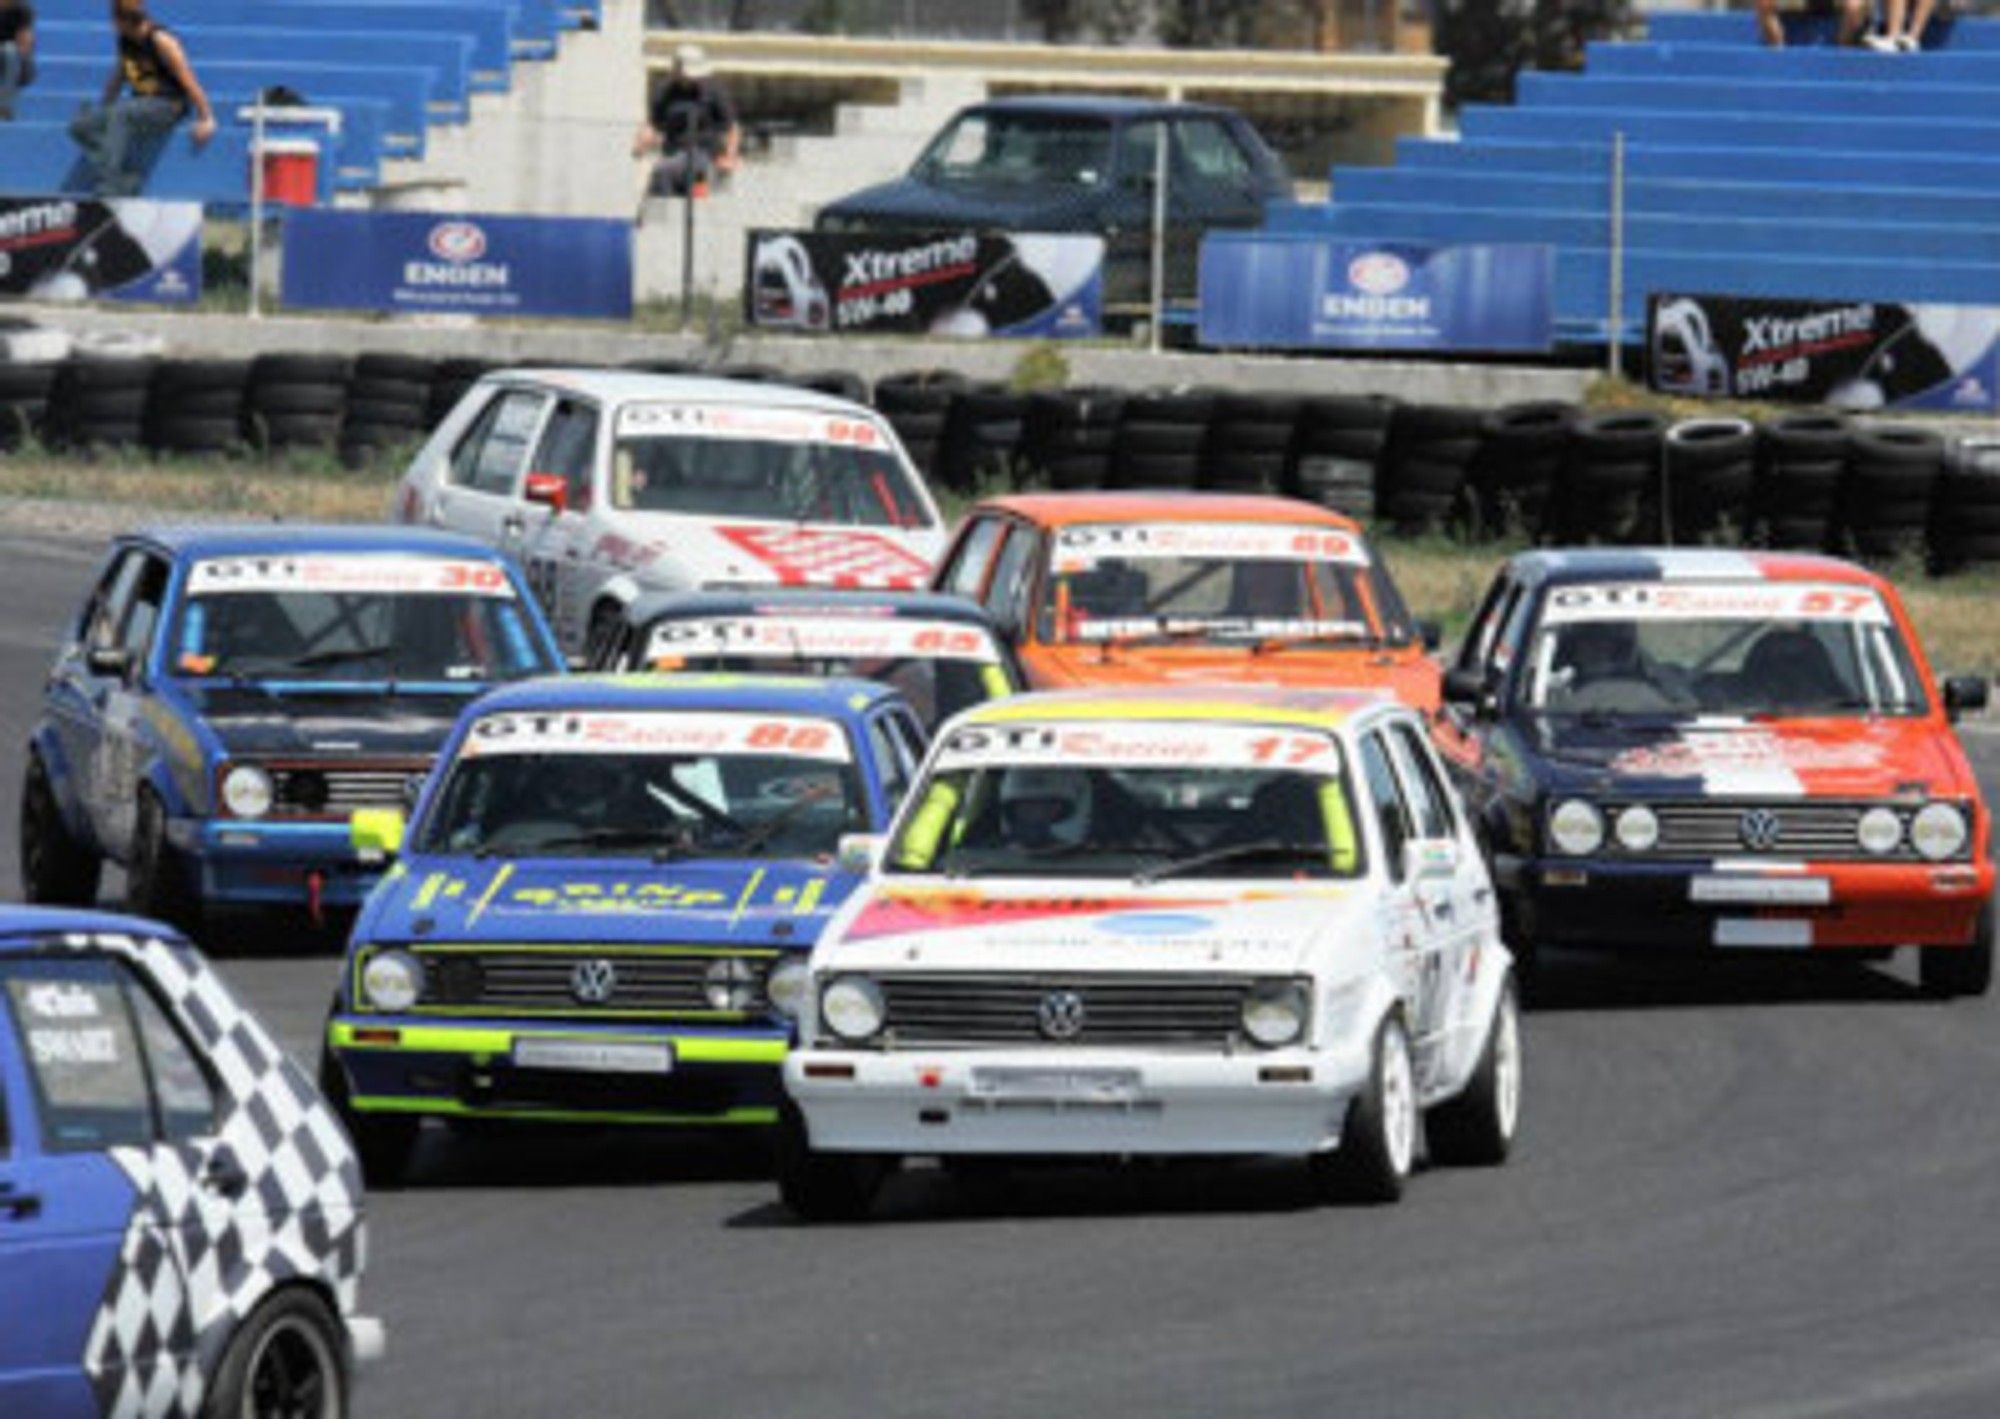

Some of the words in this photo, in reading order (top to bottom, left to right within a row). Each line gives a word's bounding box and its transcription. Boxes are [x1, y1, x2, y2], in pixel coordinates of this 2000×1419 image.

[842, 233, 979, 288] Xtreme
[404, 262, 508, 286] ENGEN
[1742, 302, 1875, 355] Xtreme
[626, 407, 704, 423] GTI
[1058, 528, 1148, 546] GTI
[204, 559, 296, 578] GTI
[438, 564, 504, 590] 30
[1554, 587, 1650, 608] GTI
[658, 620, 755, 643] GTI
[473, 714, 583, 740] GTI
[946, 727, 1057, 753] GTI
[1246, 735, 1331, 765] 17
